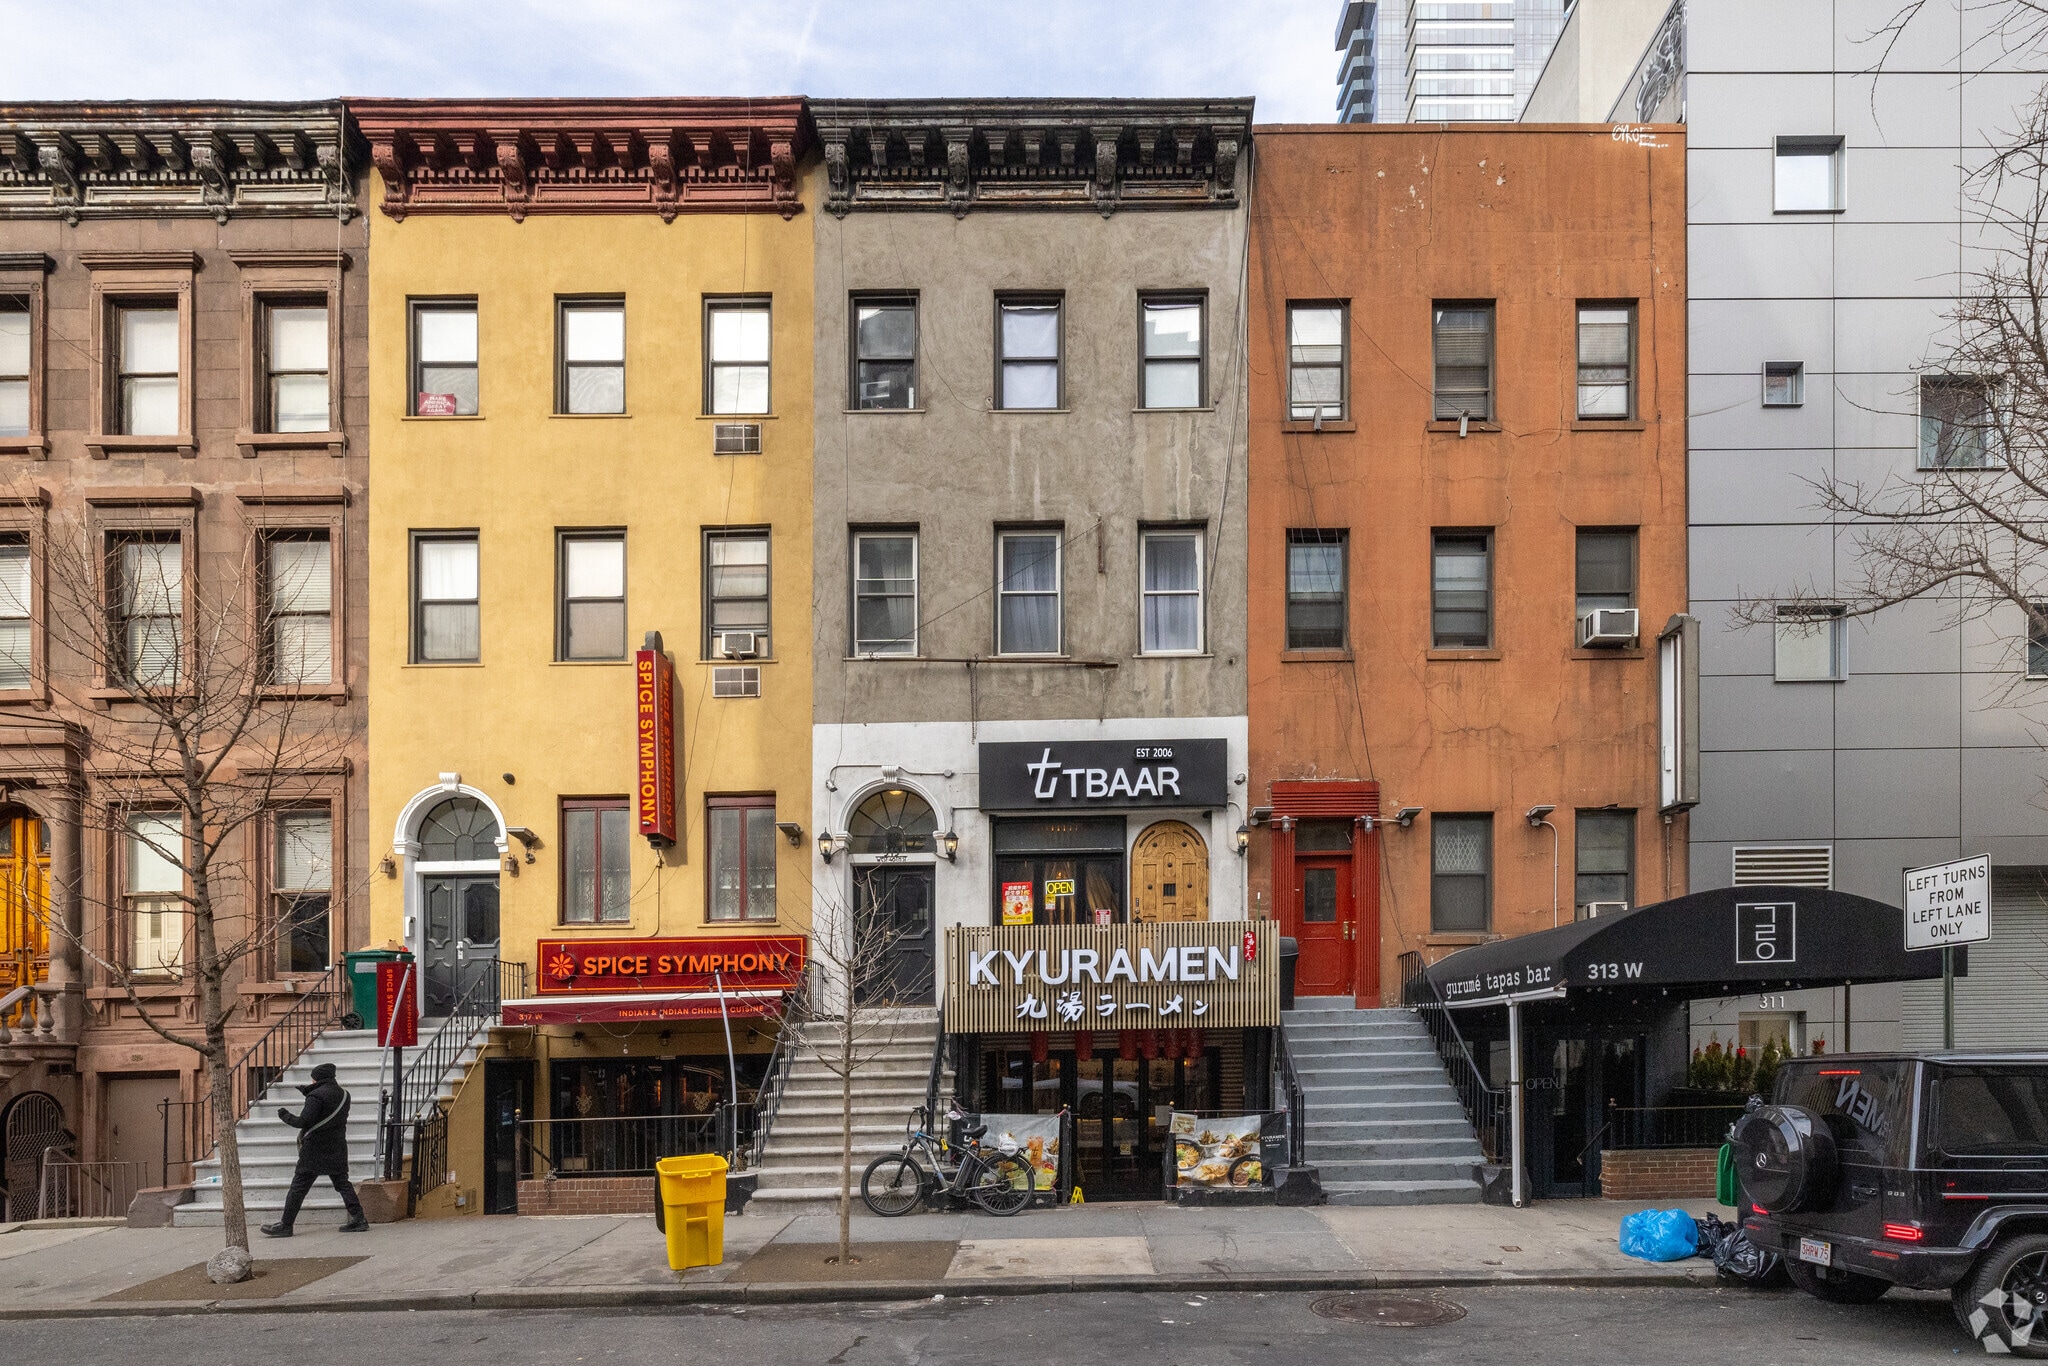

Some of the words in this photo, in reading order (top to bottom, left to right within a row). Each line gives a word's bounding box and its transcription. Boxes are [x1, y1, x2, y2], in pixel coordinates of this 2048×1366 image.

[638, 660, 654, 713] SPICE
[663, 668, 671, 722] SPICE
[1136, 748, 1150, 757] EST
[1153, 747, 1173, 757] 2006
[640, 719, 656, 824] SYMPHONY
[664, 725, 673, 828] SYMPHONY
[1062, 766, 1180, 798] TBAAR
[1047, 881, 1073, 894] OPEN
[1908, 874, 1938, 892] LEFT
[1943, 865, 1986, 885] TURNS
[1929, 886, 1964, 905] FROM
[1913, 907, 1942, 924] LEFT
[1947, 901, 1982, 918] LANE
[1930, 921, 1963, 938] ONLY
[583, 955, 648, 976] SPICE
[657, 952, 791, 974] SYMPHONY
[969, 945, 1238, 986] KYURAMEN
[1588, 963, 1619, 980] 313
[1624, 962, 1644, 978] W
[386, 968, 394, 992] SPICE
[1446, 974, 1482, 999] gurumé
[1486, 971, 1521, 993] tapas
[1526, 965, 1552, 985] bar
[661, 1007, 689, 1016] NDIAN
[691, 1006, 728, 1015] CHINES
[1016, 990, 1209, 1023] 九湯ラーメン
[1759, 995, 1785, 1009] 311
